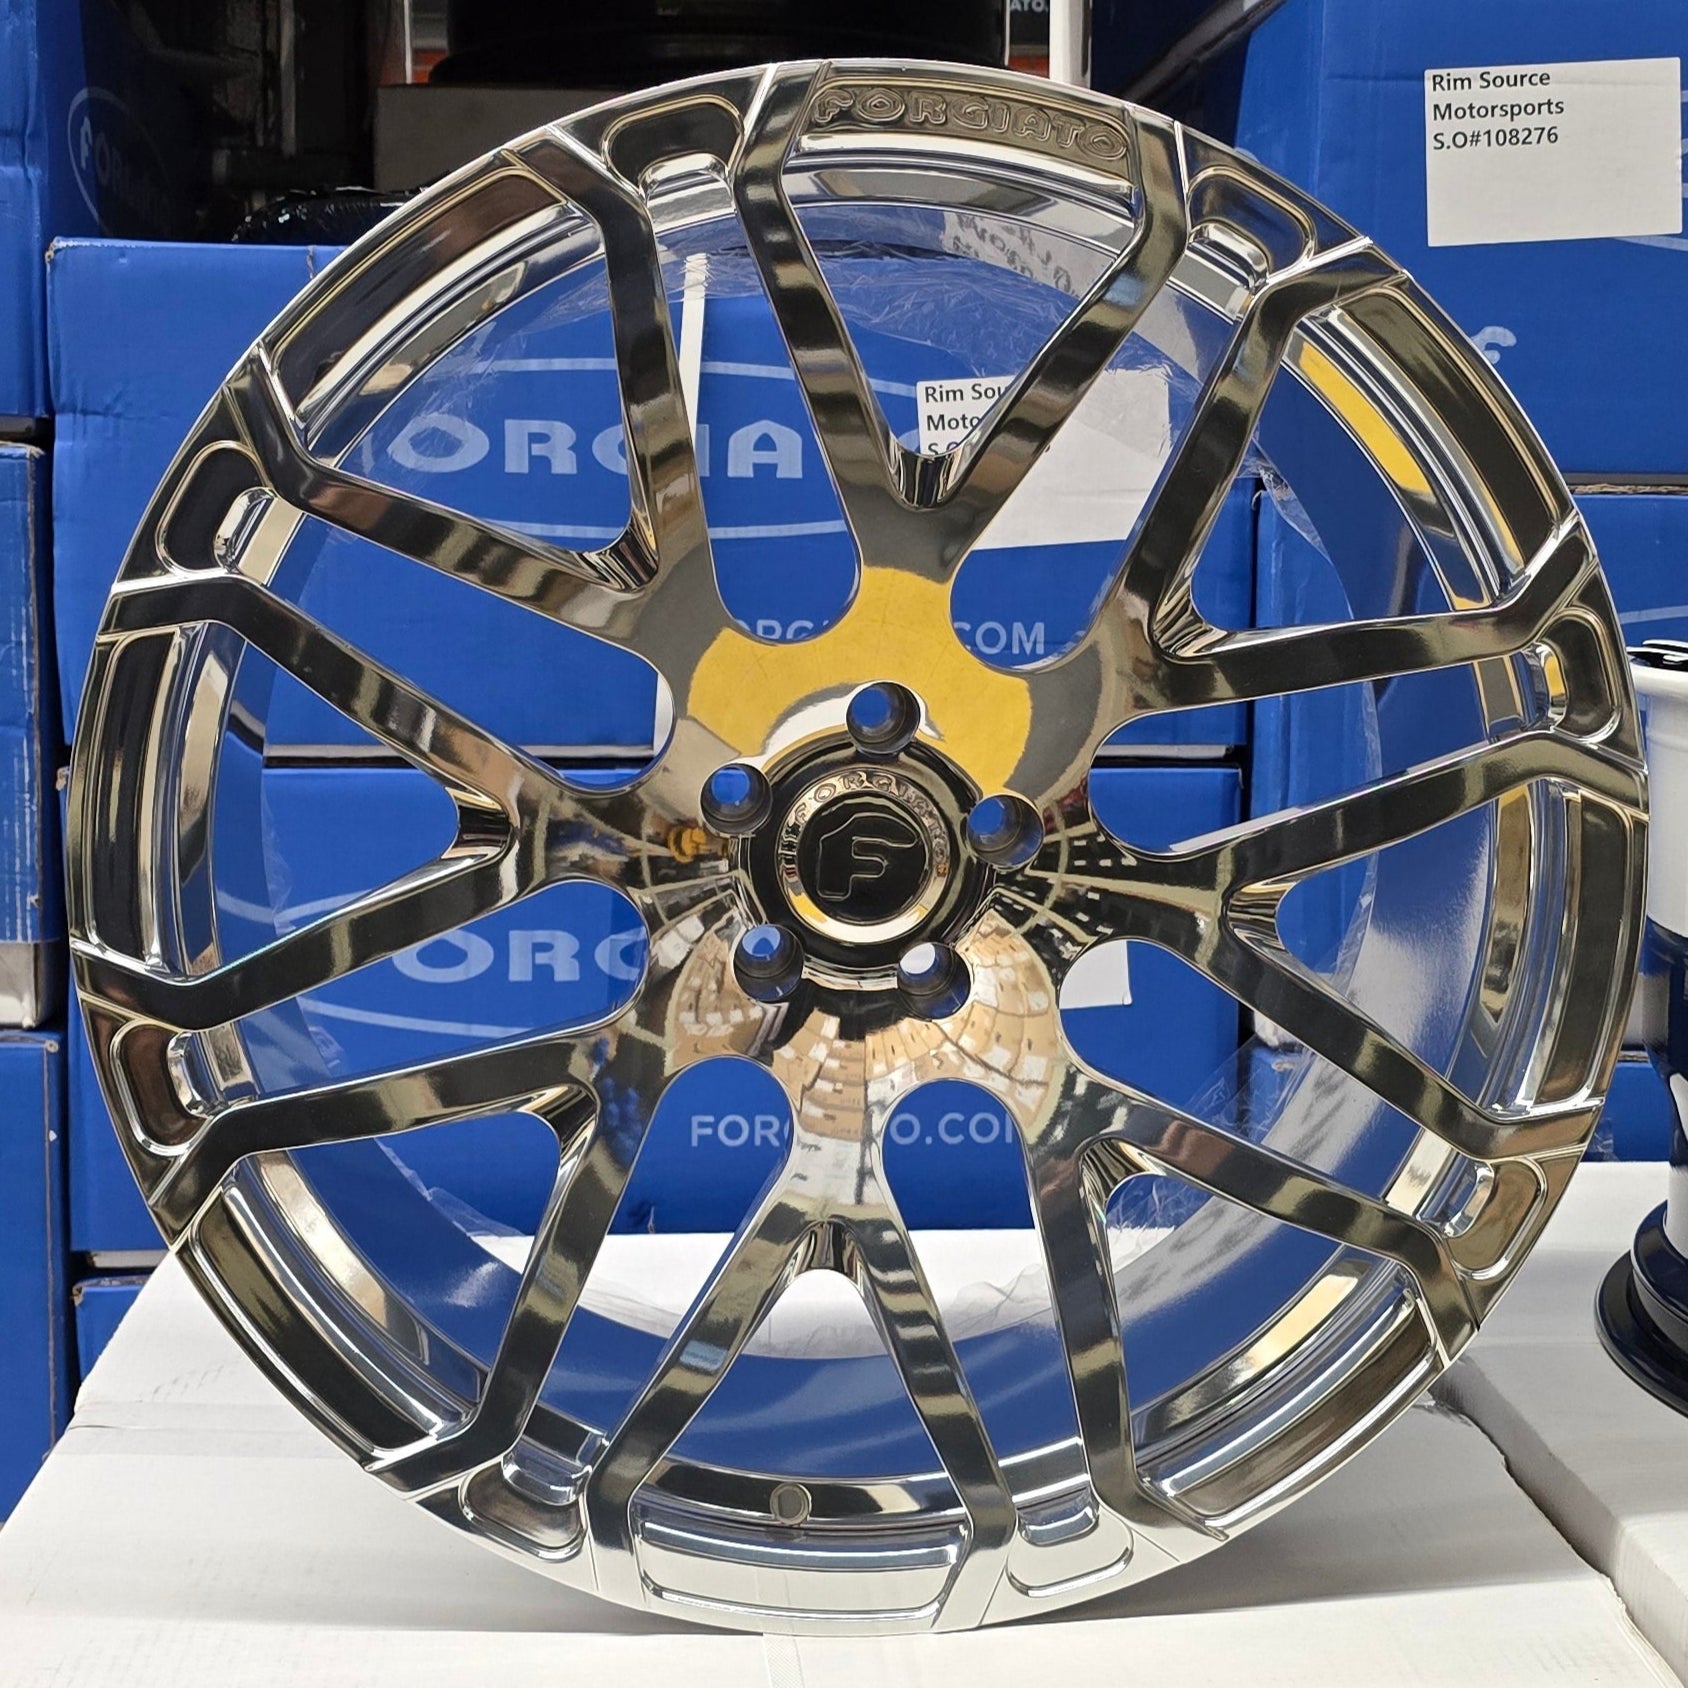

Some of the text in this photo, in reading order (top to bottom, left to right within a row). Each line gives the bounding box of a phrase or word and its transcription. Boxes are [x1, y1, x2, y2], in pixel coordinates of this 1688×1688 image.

[1432, 71, 1551, 92] Rim Source
[1433, 99, 1565, 122] Motorsports
[812, 88, 1128, 160] FORGIATO
[1433, 126, 1559, 150] S.O#108276
[925, 385, 964, 403] Rim
